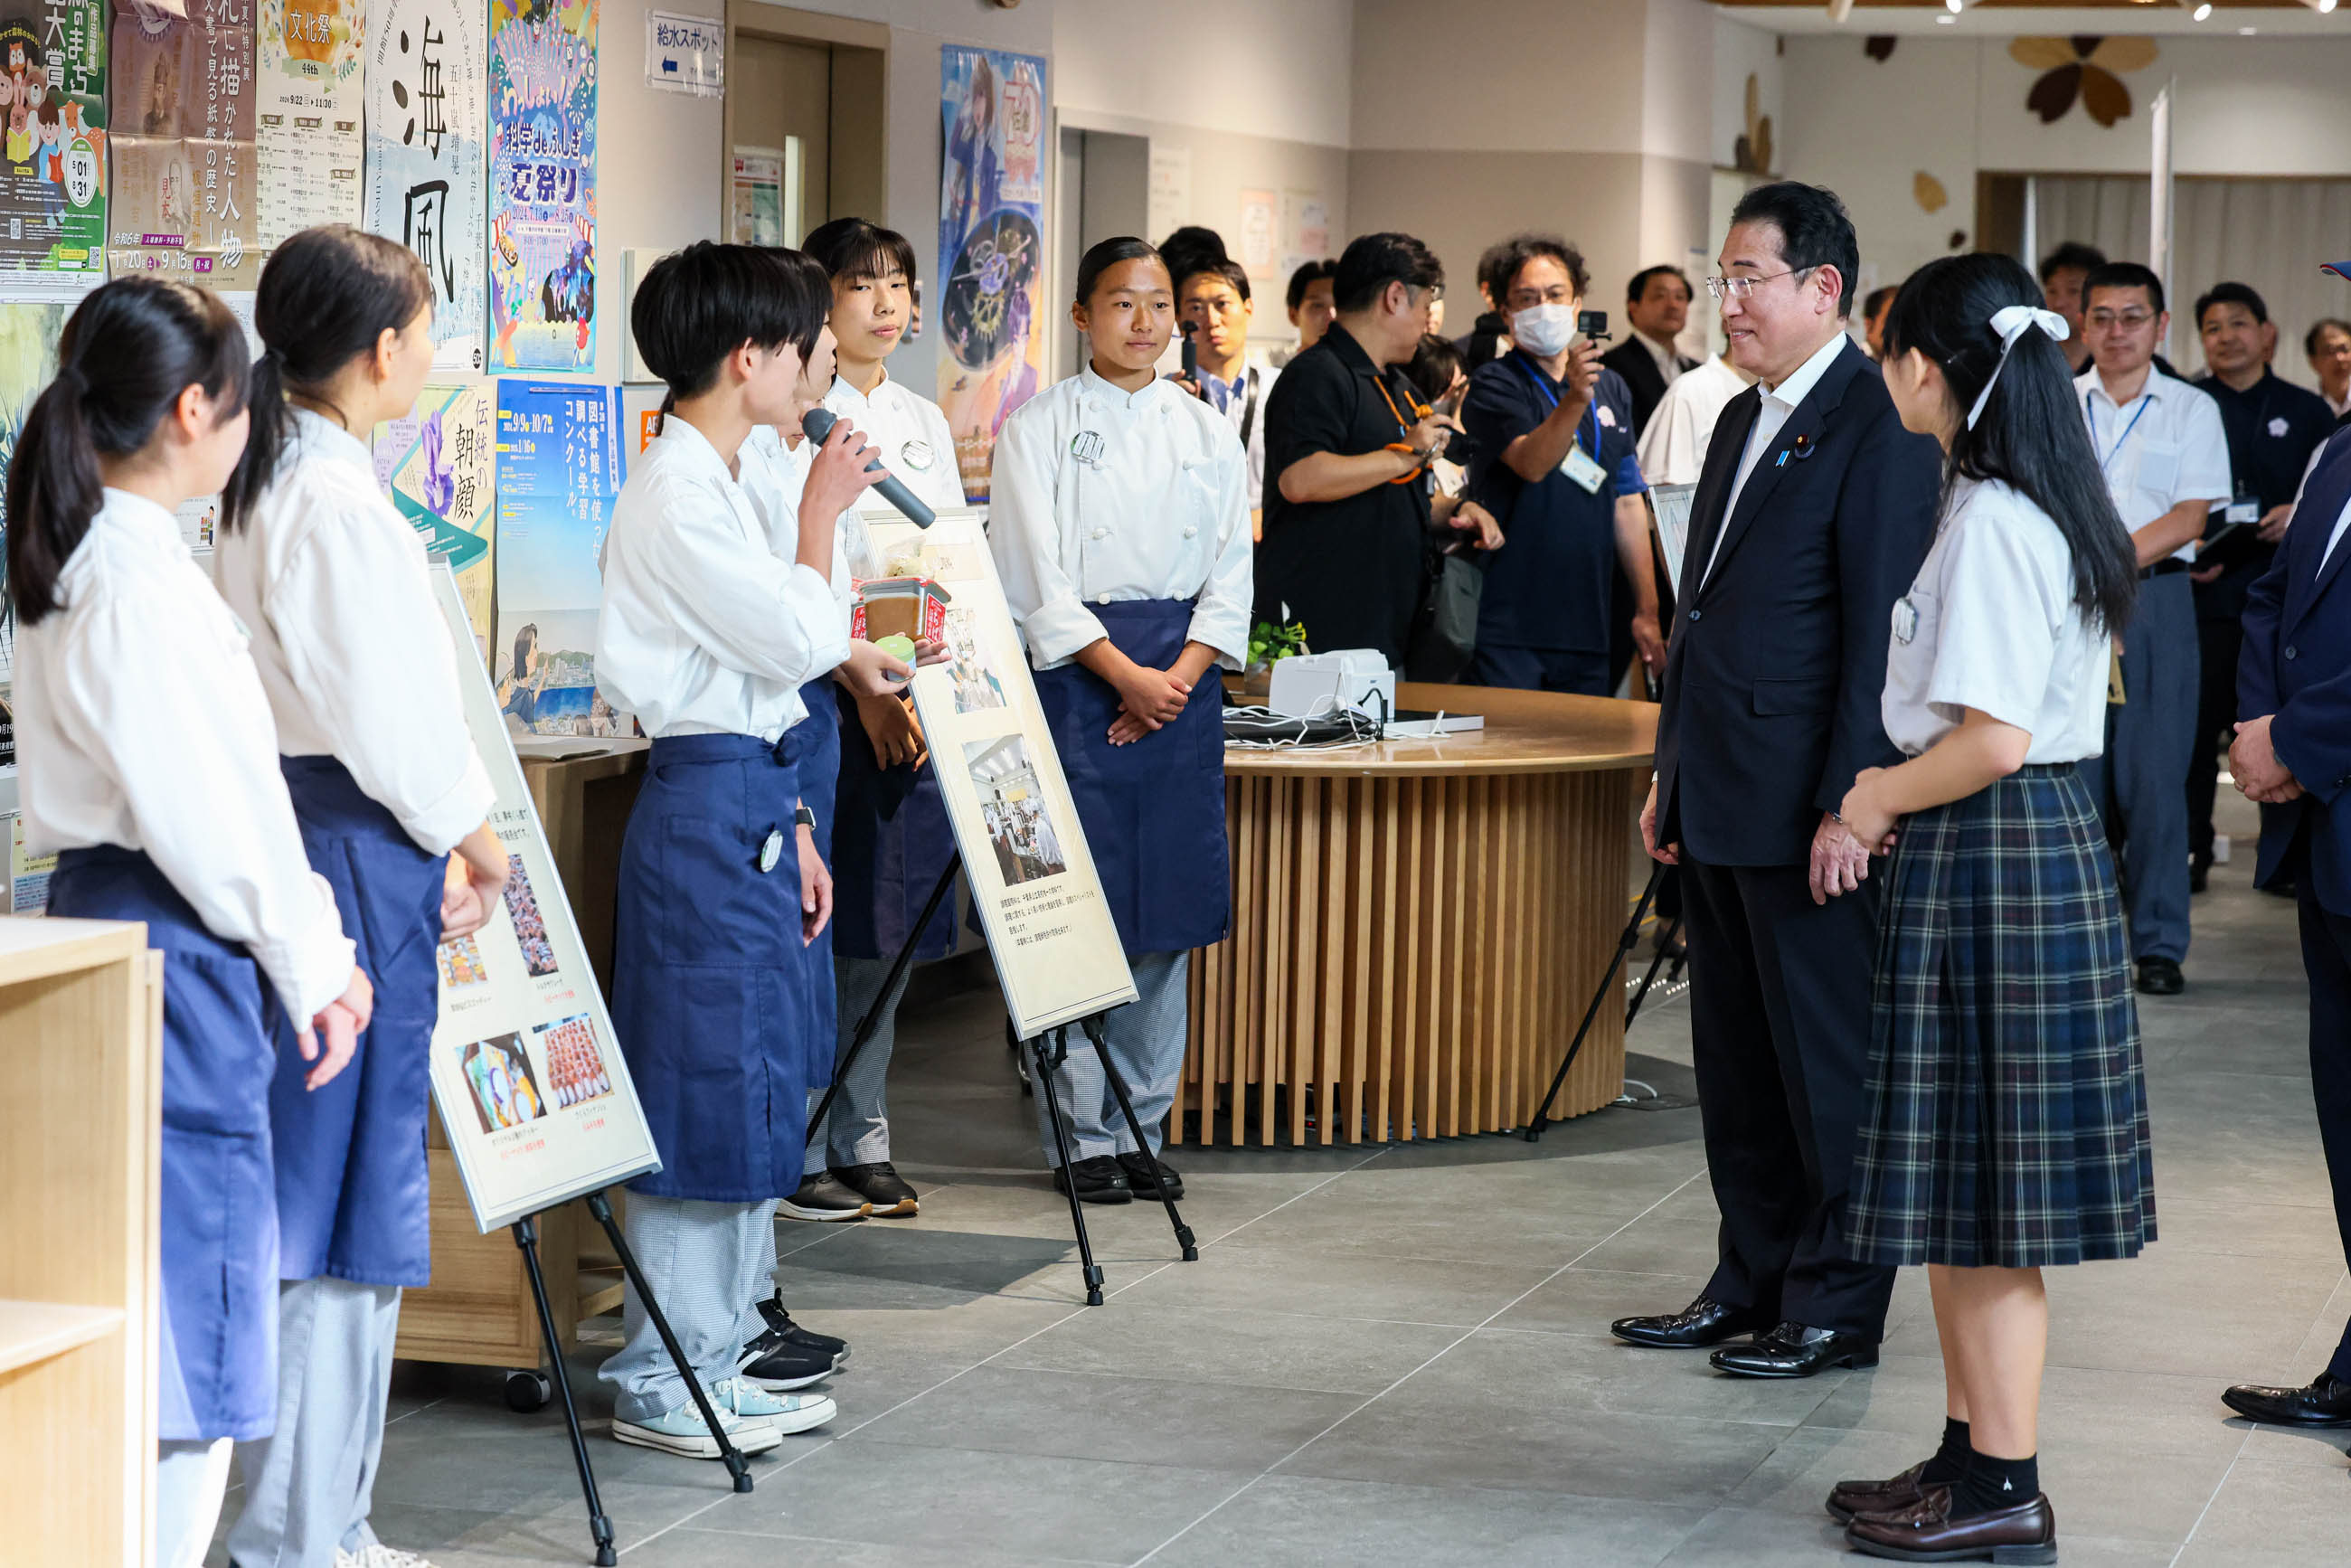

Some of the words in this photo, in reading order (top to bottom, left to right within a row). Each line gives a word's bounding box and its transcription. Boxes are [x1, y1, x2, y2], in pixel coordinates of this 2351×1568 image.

[290, 8, 332, 44] 文化祭
[656, 22, 718, 53] 給水スポット
[68, 0, 89, 95] のまち
[301, 62, 318, 75] 44th
[289, 95, 303, 106] 9/22
[316, 98, 332, 109] 11/30
[506, 122, 581, 160] 科学deふしぎ
[78, 160, 88, 176] 01
[510, 163, 579, 207] 夏祭り
[78, 181, 88, 196] 31
[161, 178, 172, 218] 見本
[114, 232, 140, 245] 令和6年
[161, 250, 192, 269] 9月16日
[645, 415, 658, 434] AE
[475, 398, 488, 489] 伝統の
[565, 401, 578, 507] コンクール
[575, 400, 589, 520] 調べる学習
[454, 423, 476, 520] 朝顔
[588, 401, 603, 559] 図書館を使った
